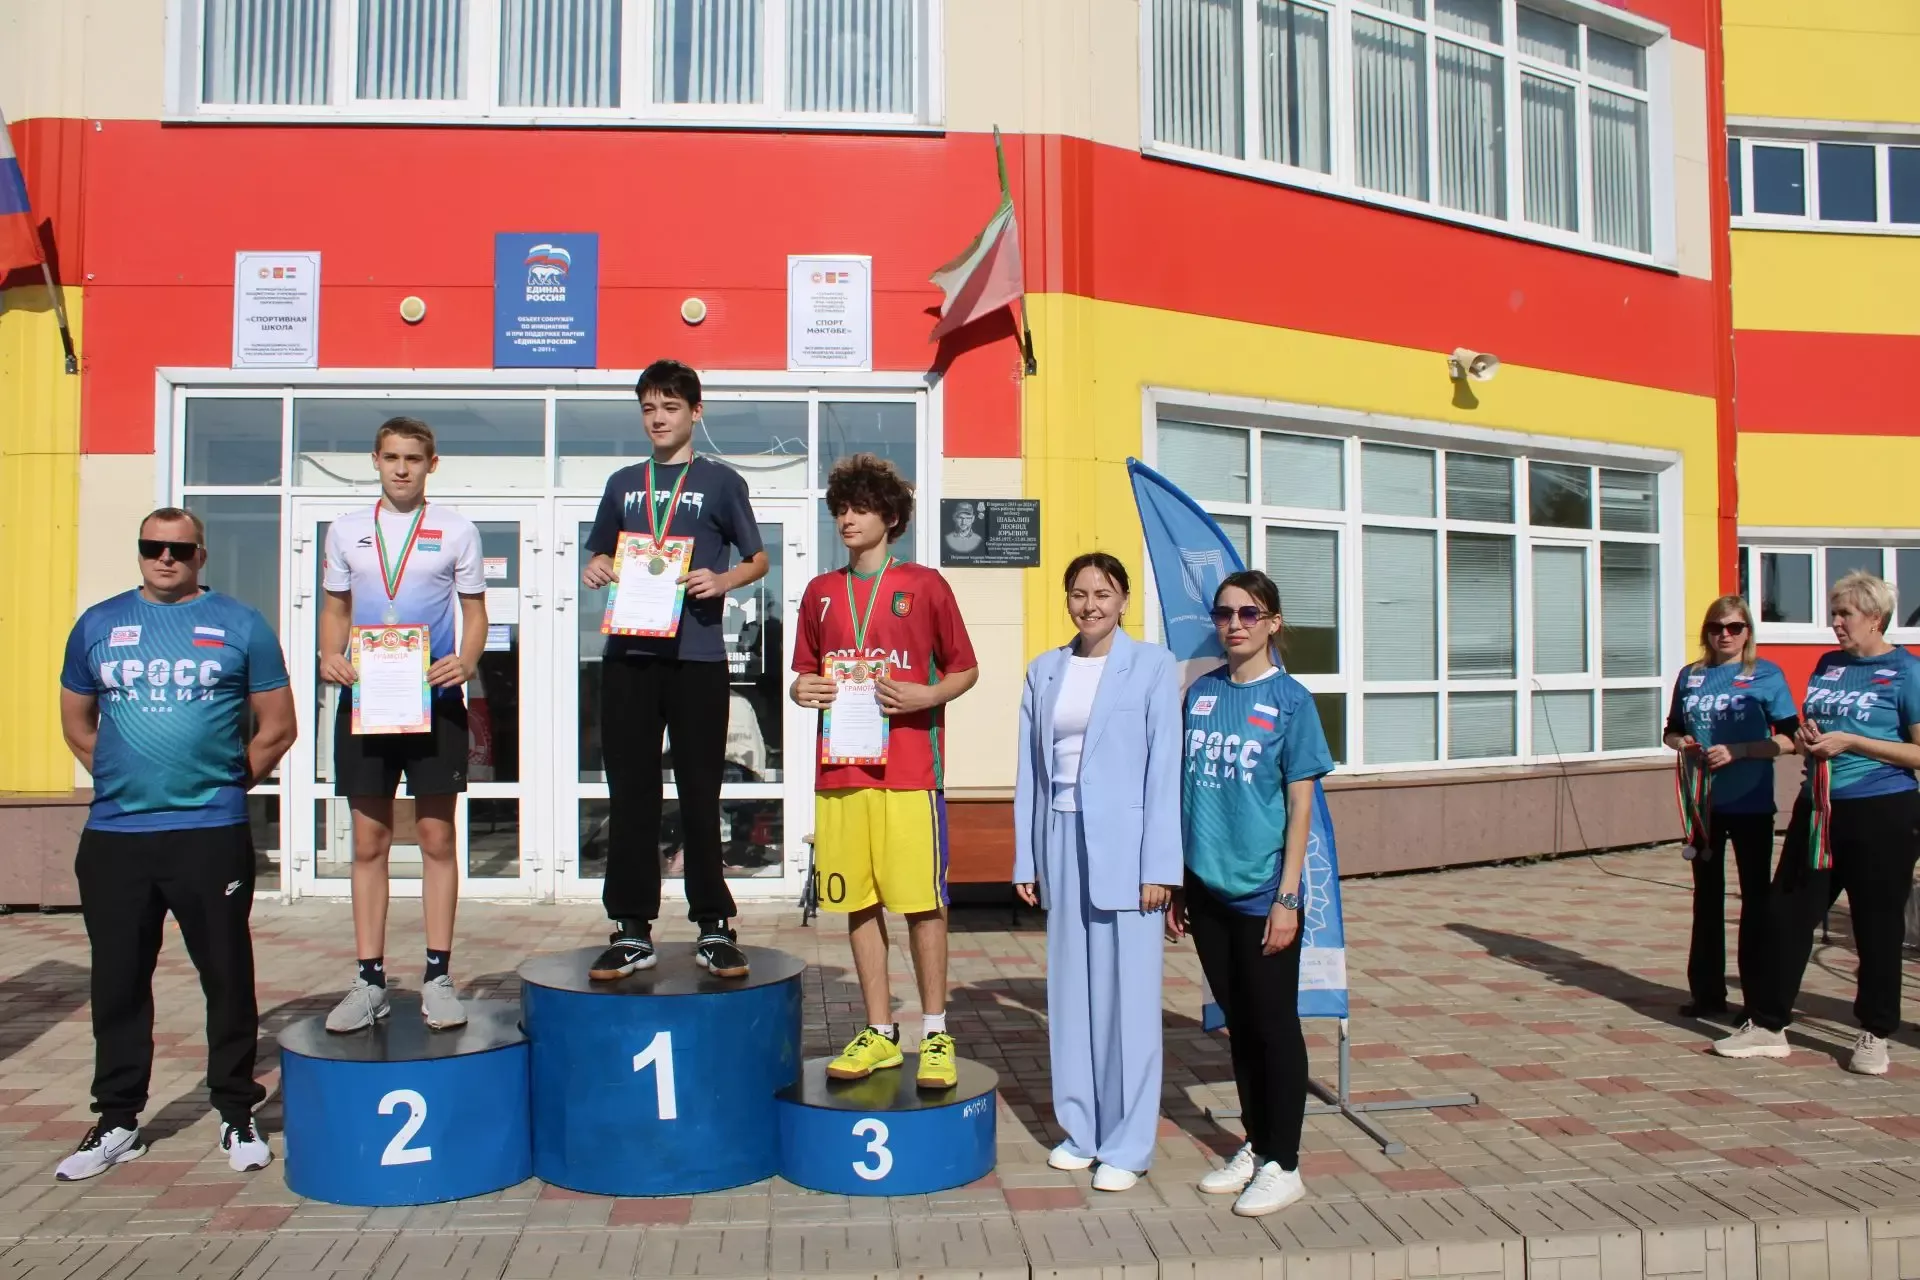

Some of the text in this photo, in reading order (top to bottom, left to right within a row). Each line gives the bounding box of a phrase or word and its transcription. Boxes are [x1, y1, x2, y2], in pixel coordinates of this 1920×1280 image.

[820, 596, 831, 622] 7
[100, 659, 222, 688] КРОСС
[111, 689, 214, 702] НАЦИИ
[815, 870, 846, 904] 10
[633, 1031, 677, 1120] 1
[378, 1089, 432, 1165] 2
[852, 1117, 893, 1181] 3
